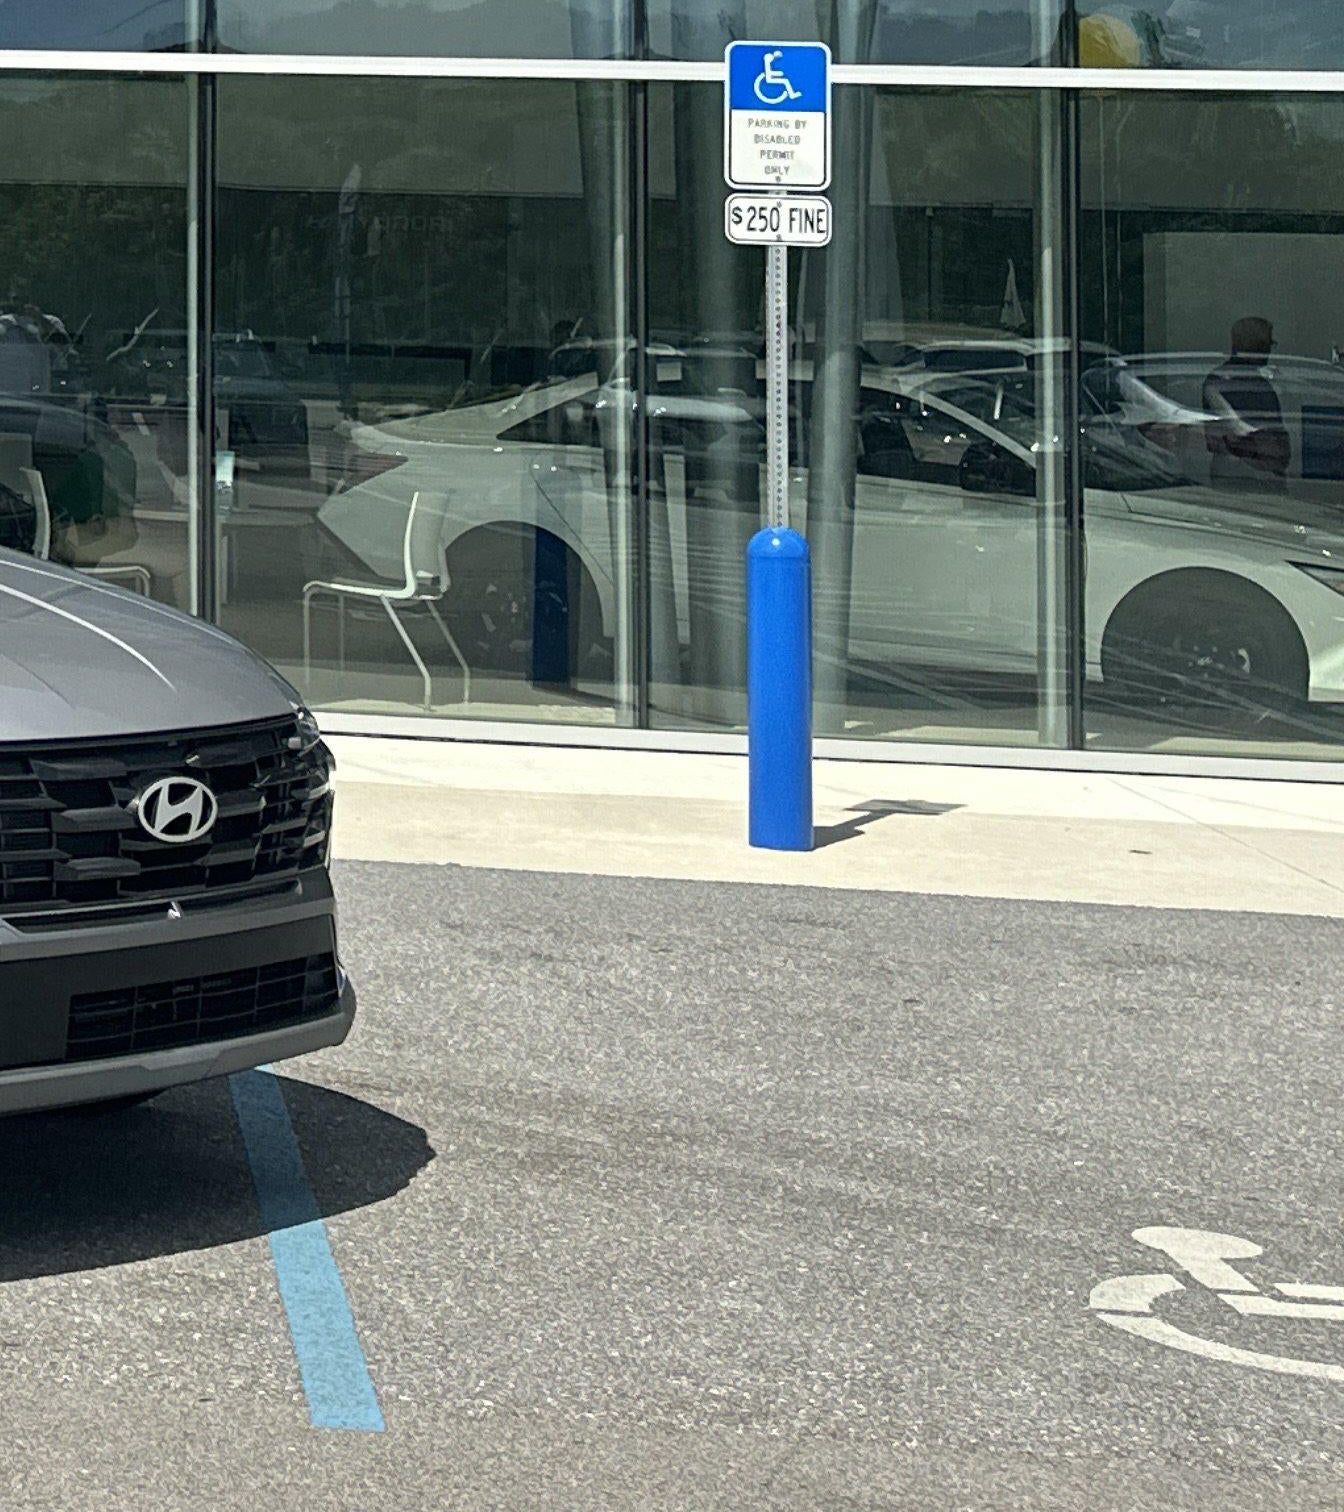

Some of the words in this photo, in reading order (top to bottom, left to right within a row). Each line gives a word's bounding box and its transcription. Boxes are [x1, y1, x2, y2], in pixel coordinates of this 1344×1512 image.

[747, 117, 790, 129] PARKING
[794, 119, 808, 130] BY
[753, 133, 801, 145] DISABLED
[759, 149, 795, 160] PERMIT
[764, 165, 791, 176] ONLY
[731, 205, 780, 232] $250
[788, 207, 826, 234] FINE
